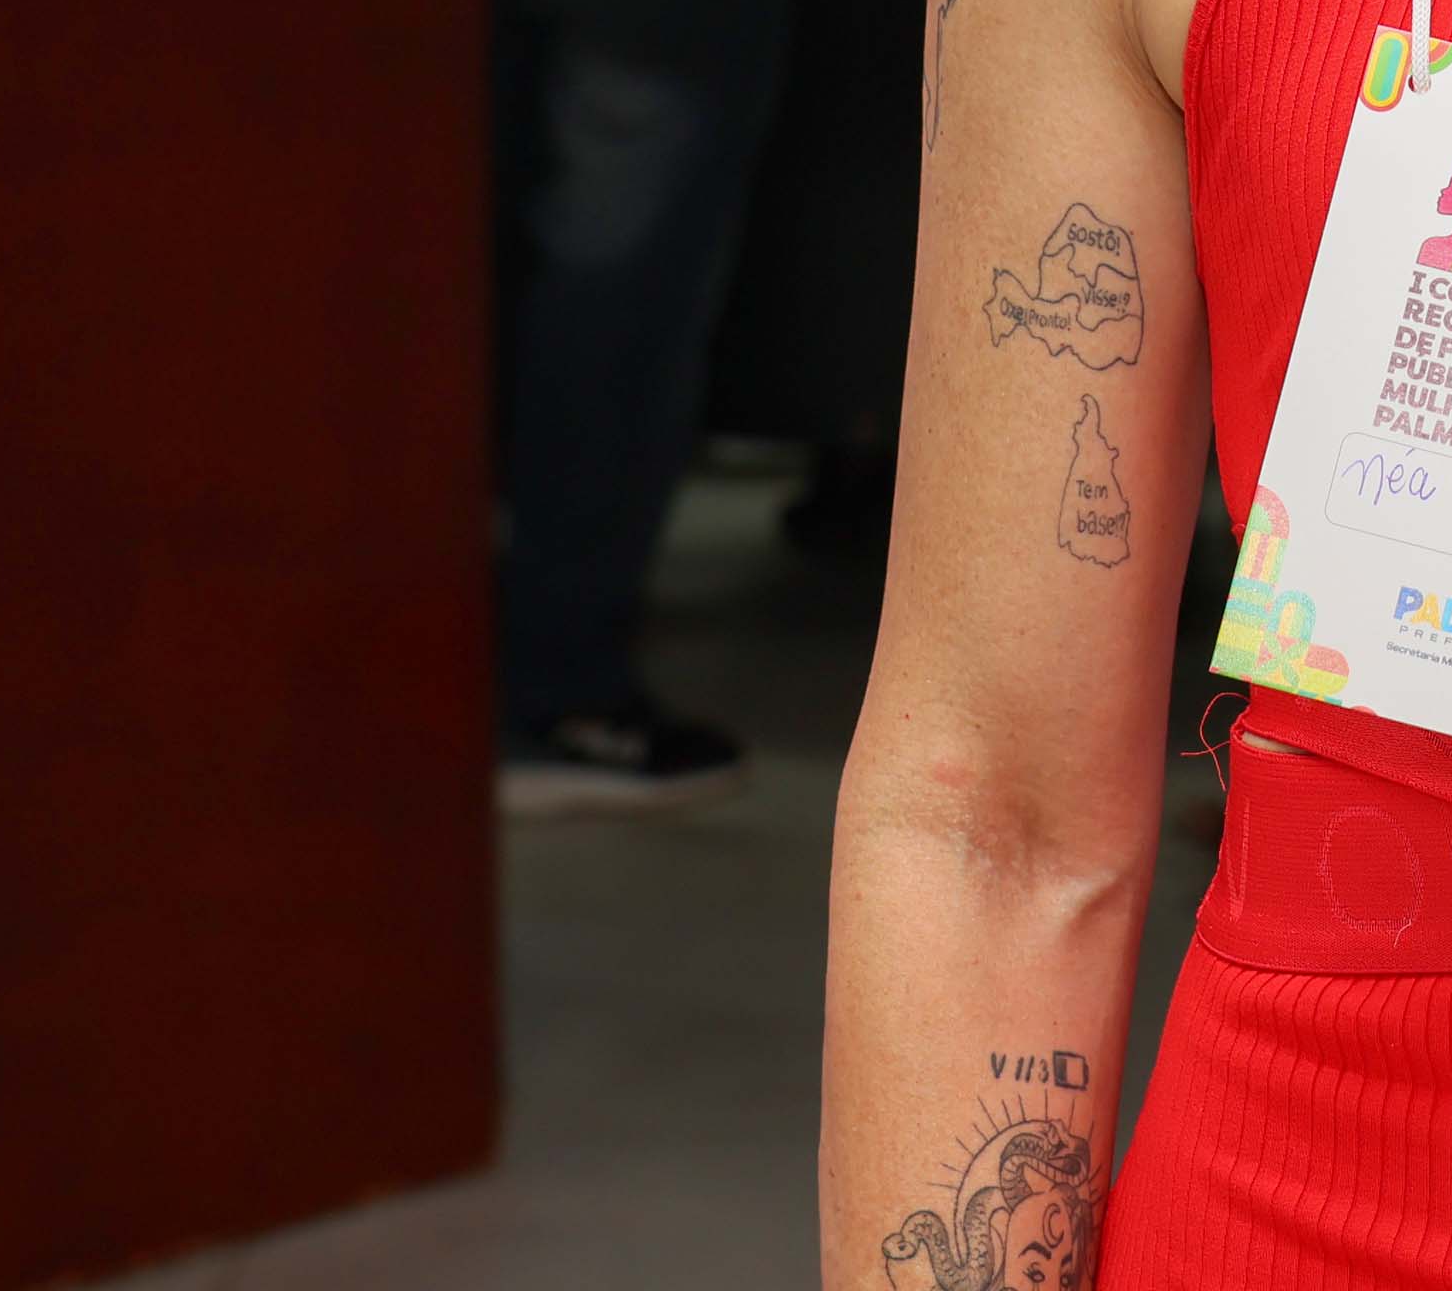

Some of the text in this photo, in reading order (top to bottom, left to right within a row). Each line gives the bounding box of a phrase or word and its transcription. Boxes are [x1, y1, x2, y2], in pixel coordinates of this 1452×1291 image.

[1408, 270, 1427, 295] I
[1394, 325, 1436, 354] DE
[1076, 480, 1109, 499] Tem
[1386, 641, 1440, 663] Secretaria
